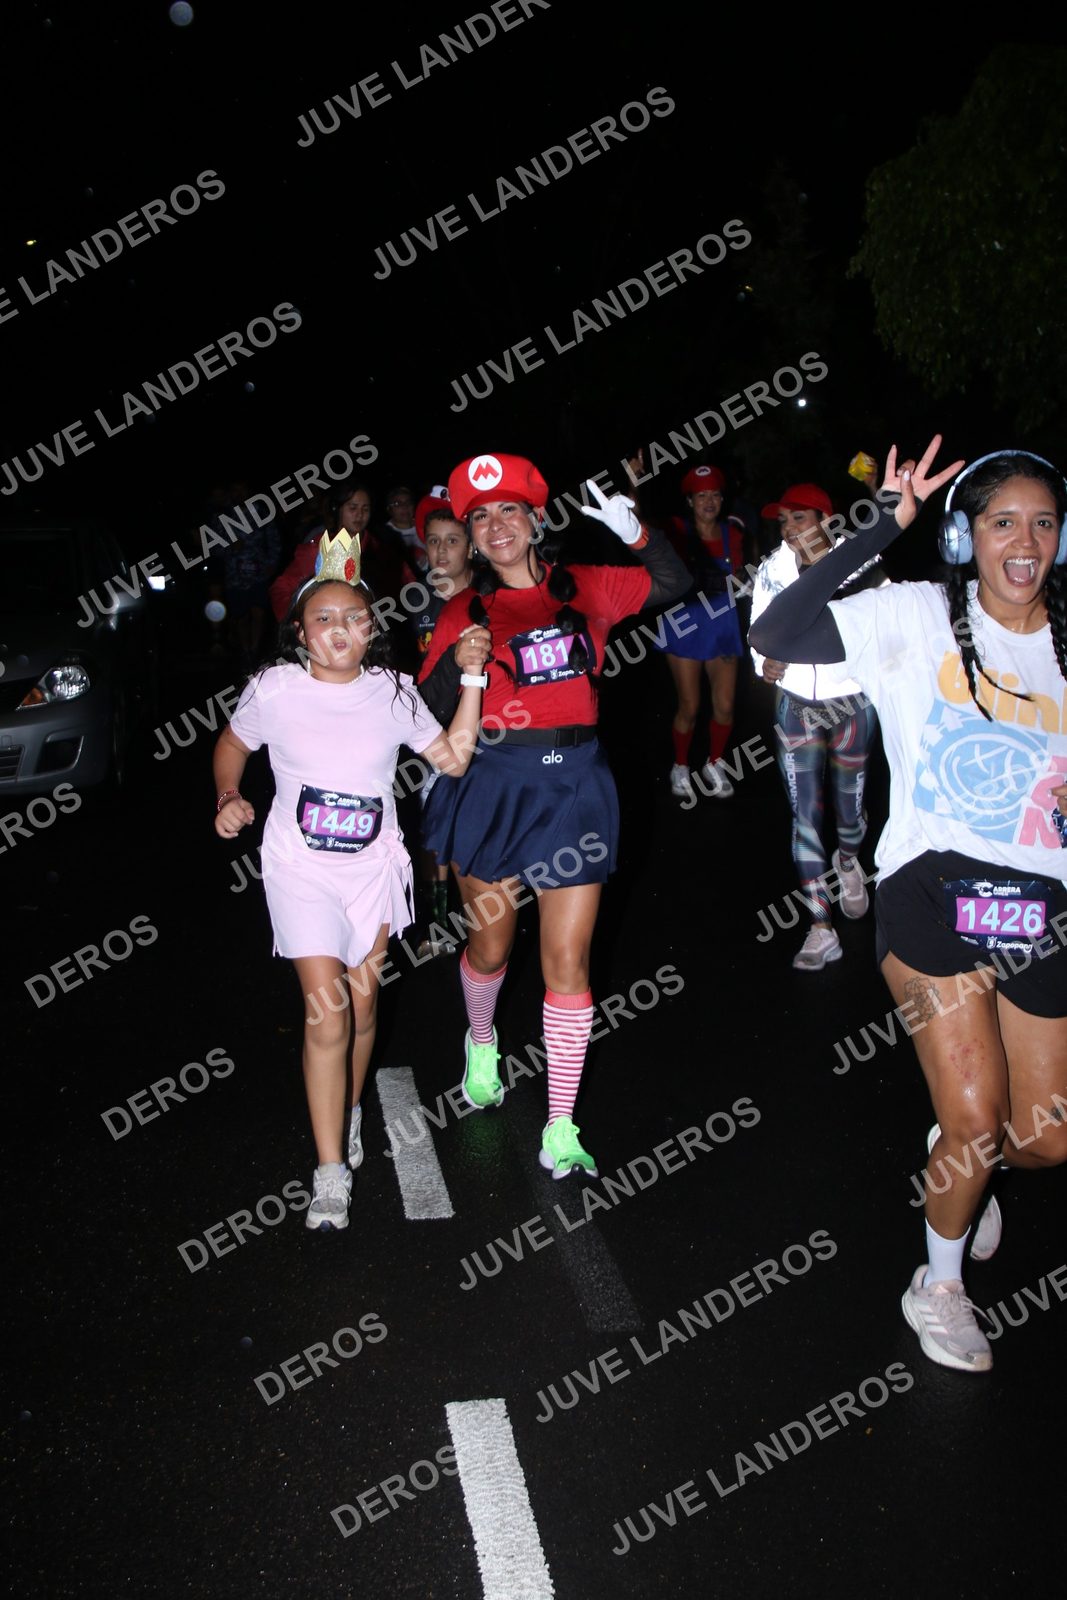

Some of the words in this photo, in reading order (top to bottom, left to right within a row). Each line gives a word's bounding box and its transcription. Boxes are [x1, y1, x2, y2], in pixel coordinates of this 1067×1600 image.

[525, 639, 568, 670] 181
[542, 750, 563, 764] alo
[308, 806, 374, 837] 1449
[962, 900, 1042, 933] 1426
